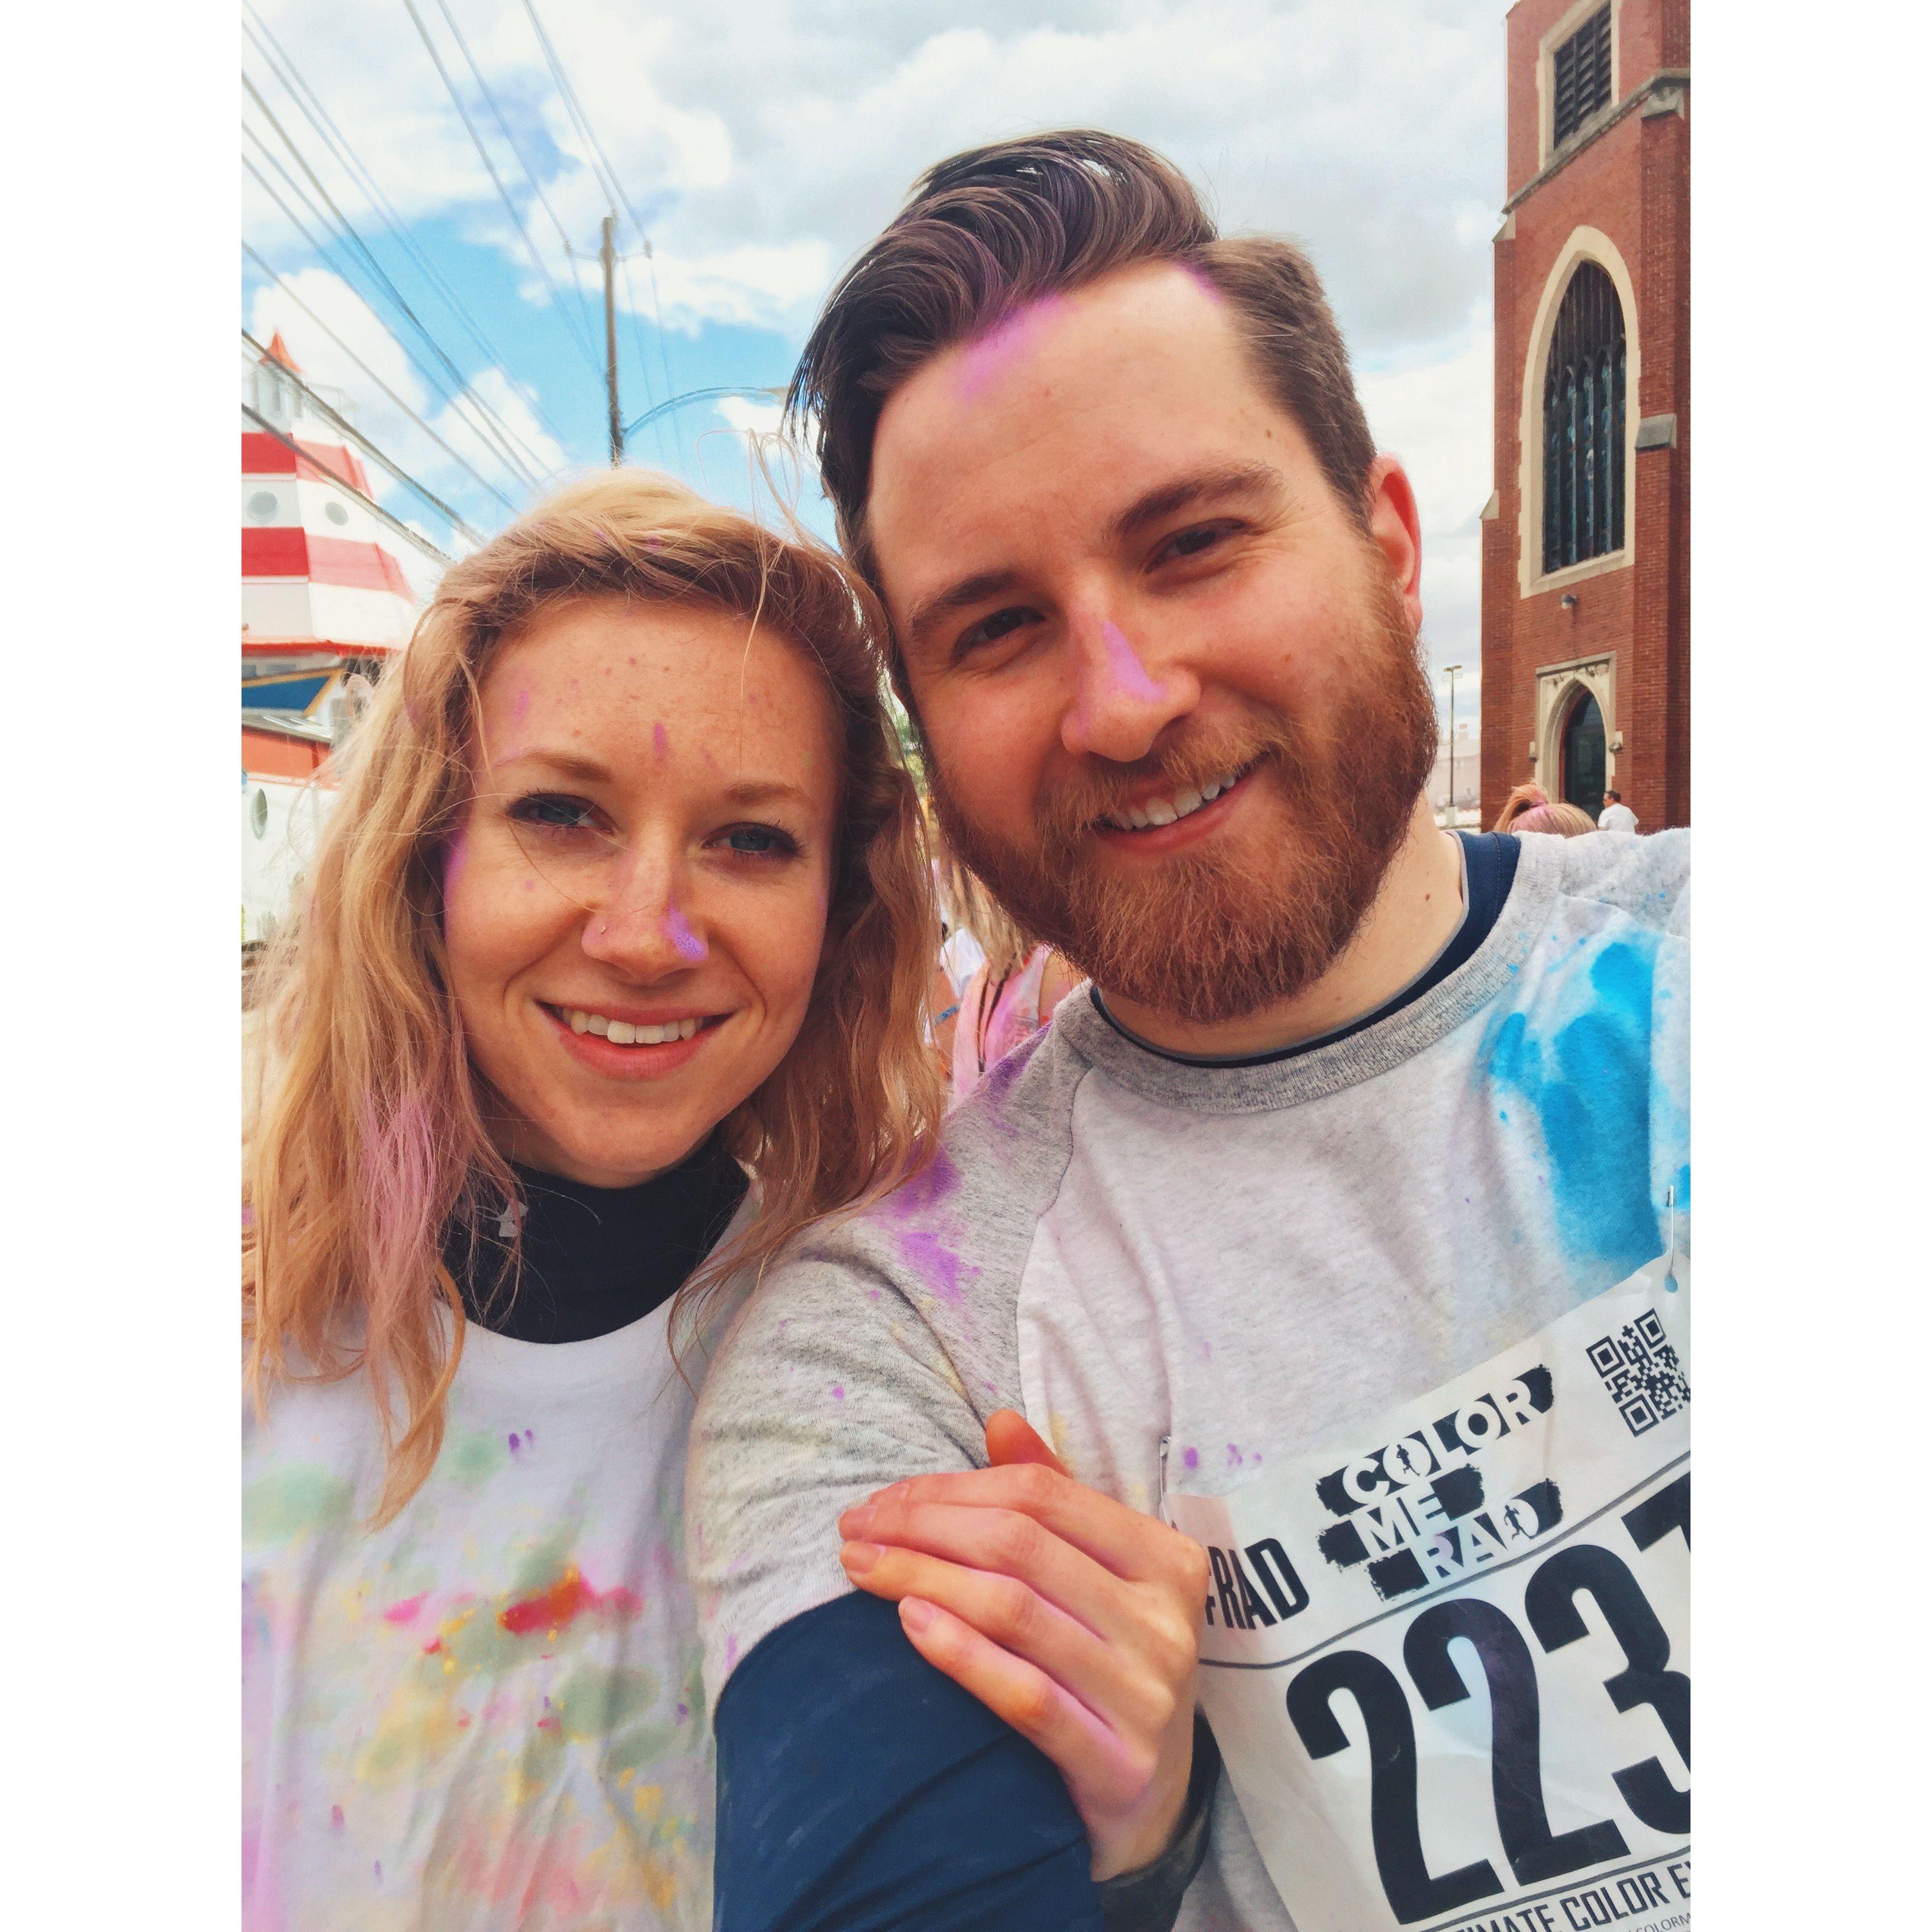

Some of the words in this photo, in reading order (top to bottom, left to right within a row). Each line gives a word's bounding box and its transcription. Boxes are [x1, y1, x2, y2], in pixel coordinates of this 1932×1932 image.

[1342, 1379, 1543, 1505] COLOR
[1350, 1482, 1452, 1559] ME
[1410, 1498, 1540, 1584] RAD
[1559, 1871, 1670, 1931] COLOR
[1667, 1860, 1691, 1899] E
